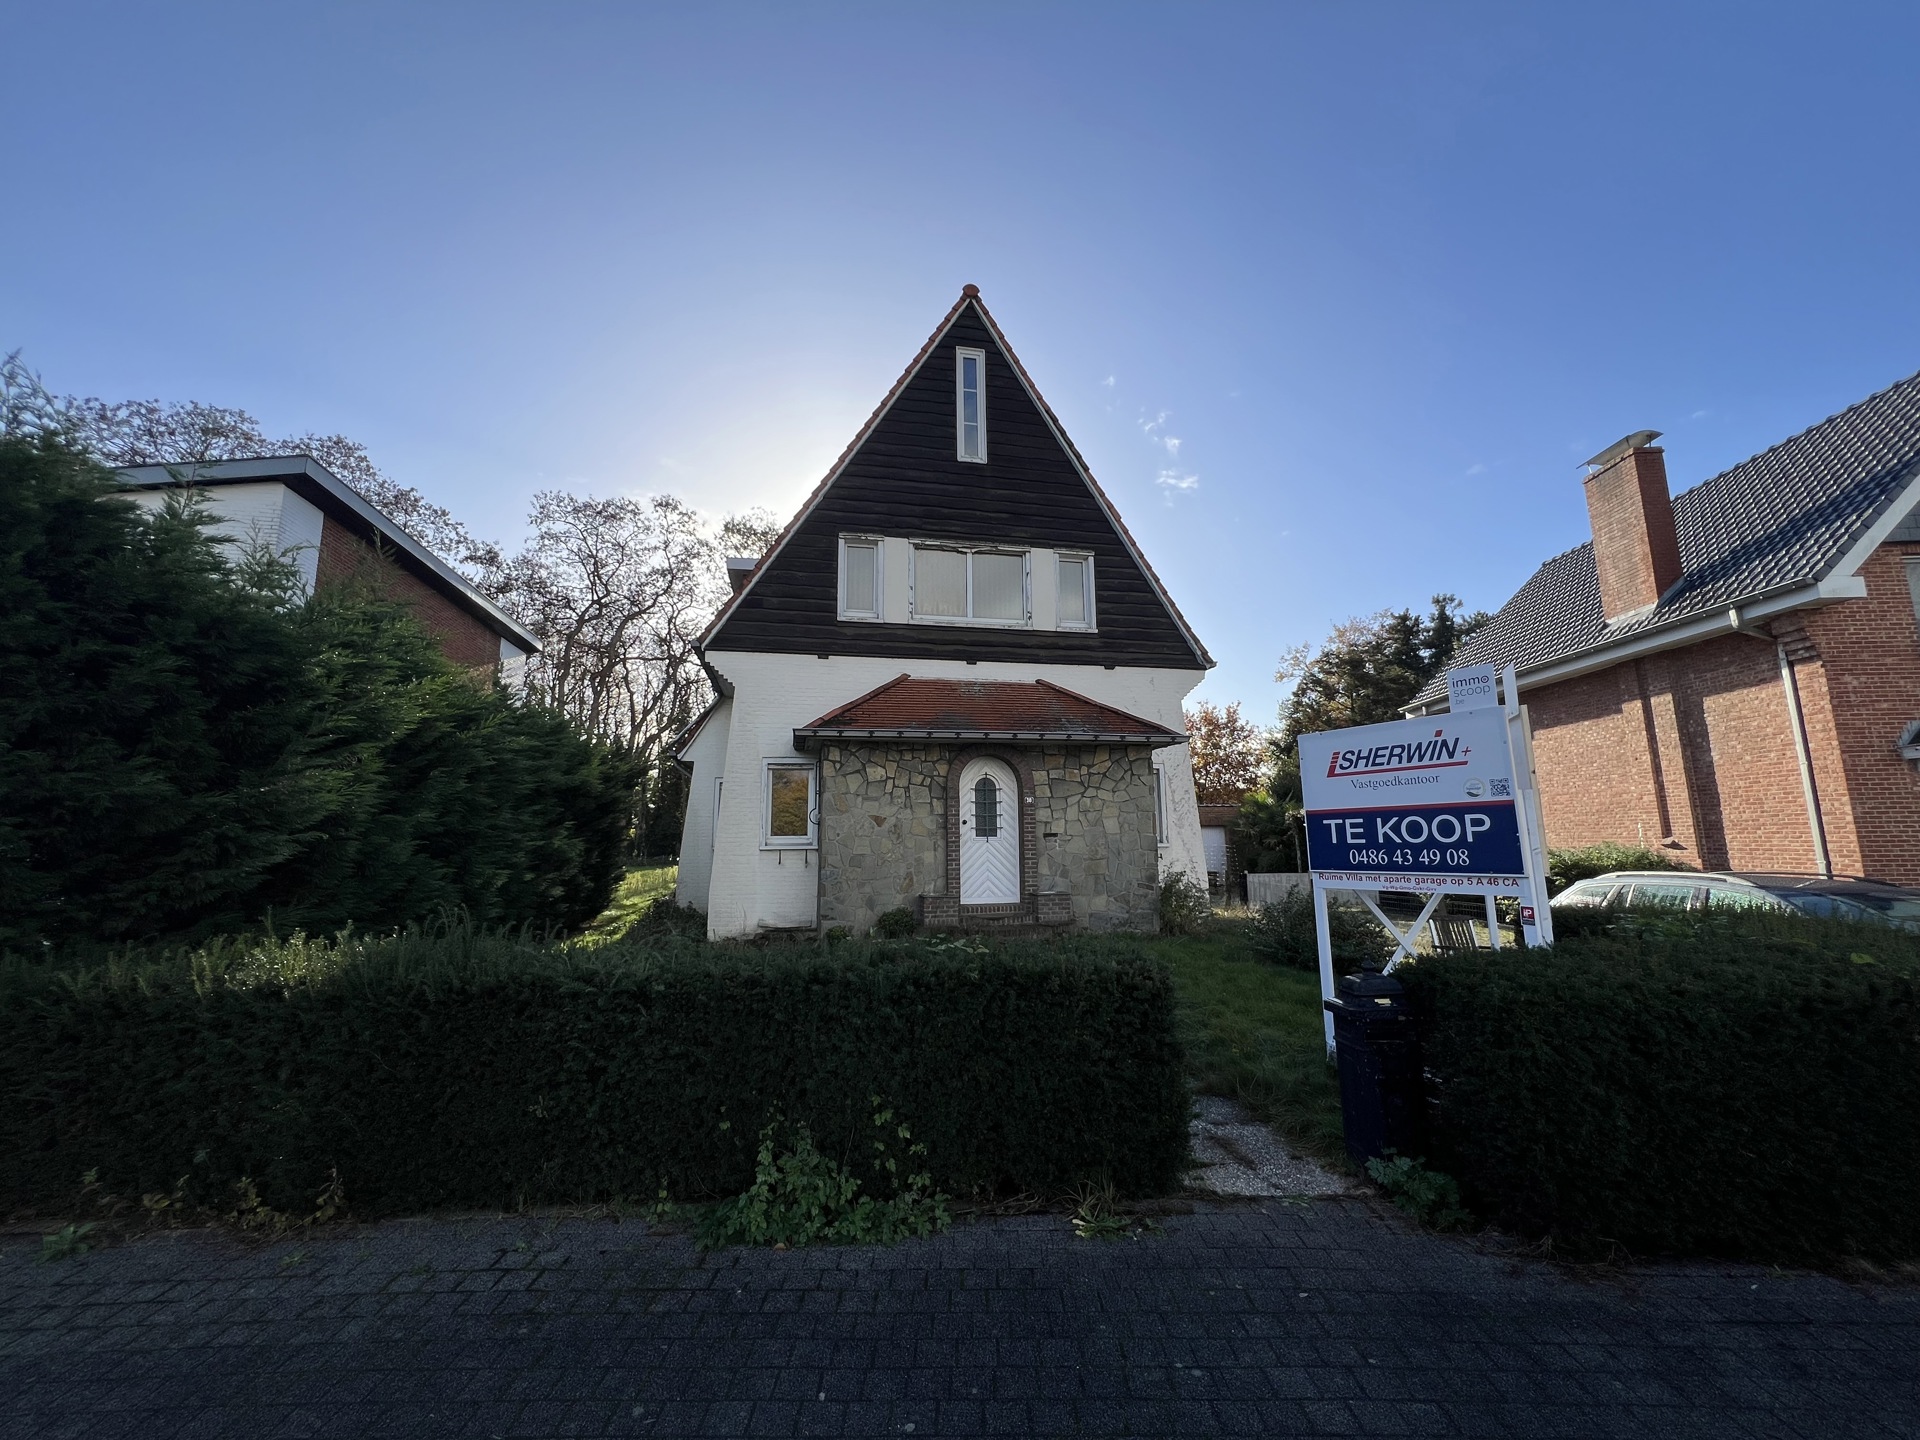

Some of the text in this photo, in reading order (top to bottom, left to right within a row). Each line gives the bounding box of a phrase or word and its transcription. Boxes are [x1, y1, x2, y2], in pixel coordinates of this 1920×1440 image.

[1452, 675, 1490, 688] immo
[1453, 685, 1491, 698] scoop
[1350, 775, 1441, 790] Vastgoedkantoor
[1322, 813, 1491, 844] TE KOOP
[1349, 848, 1470, 866] 0486 43 49 08
[1318, 872, 1520, 888] Ruime Villa met aparte garage op 5 A 46 CA
